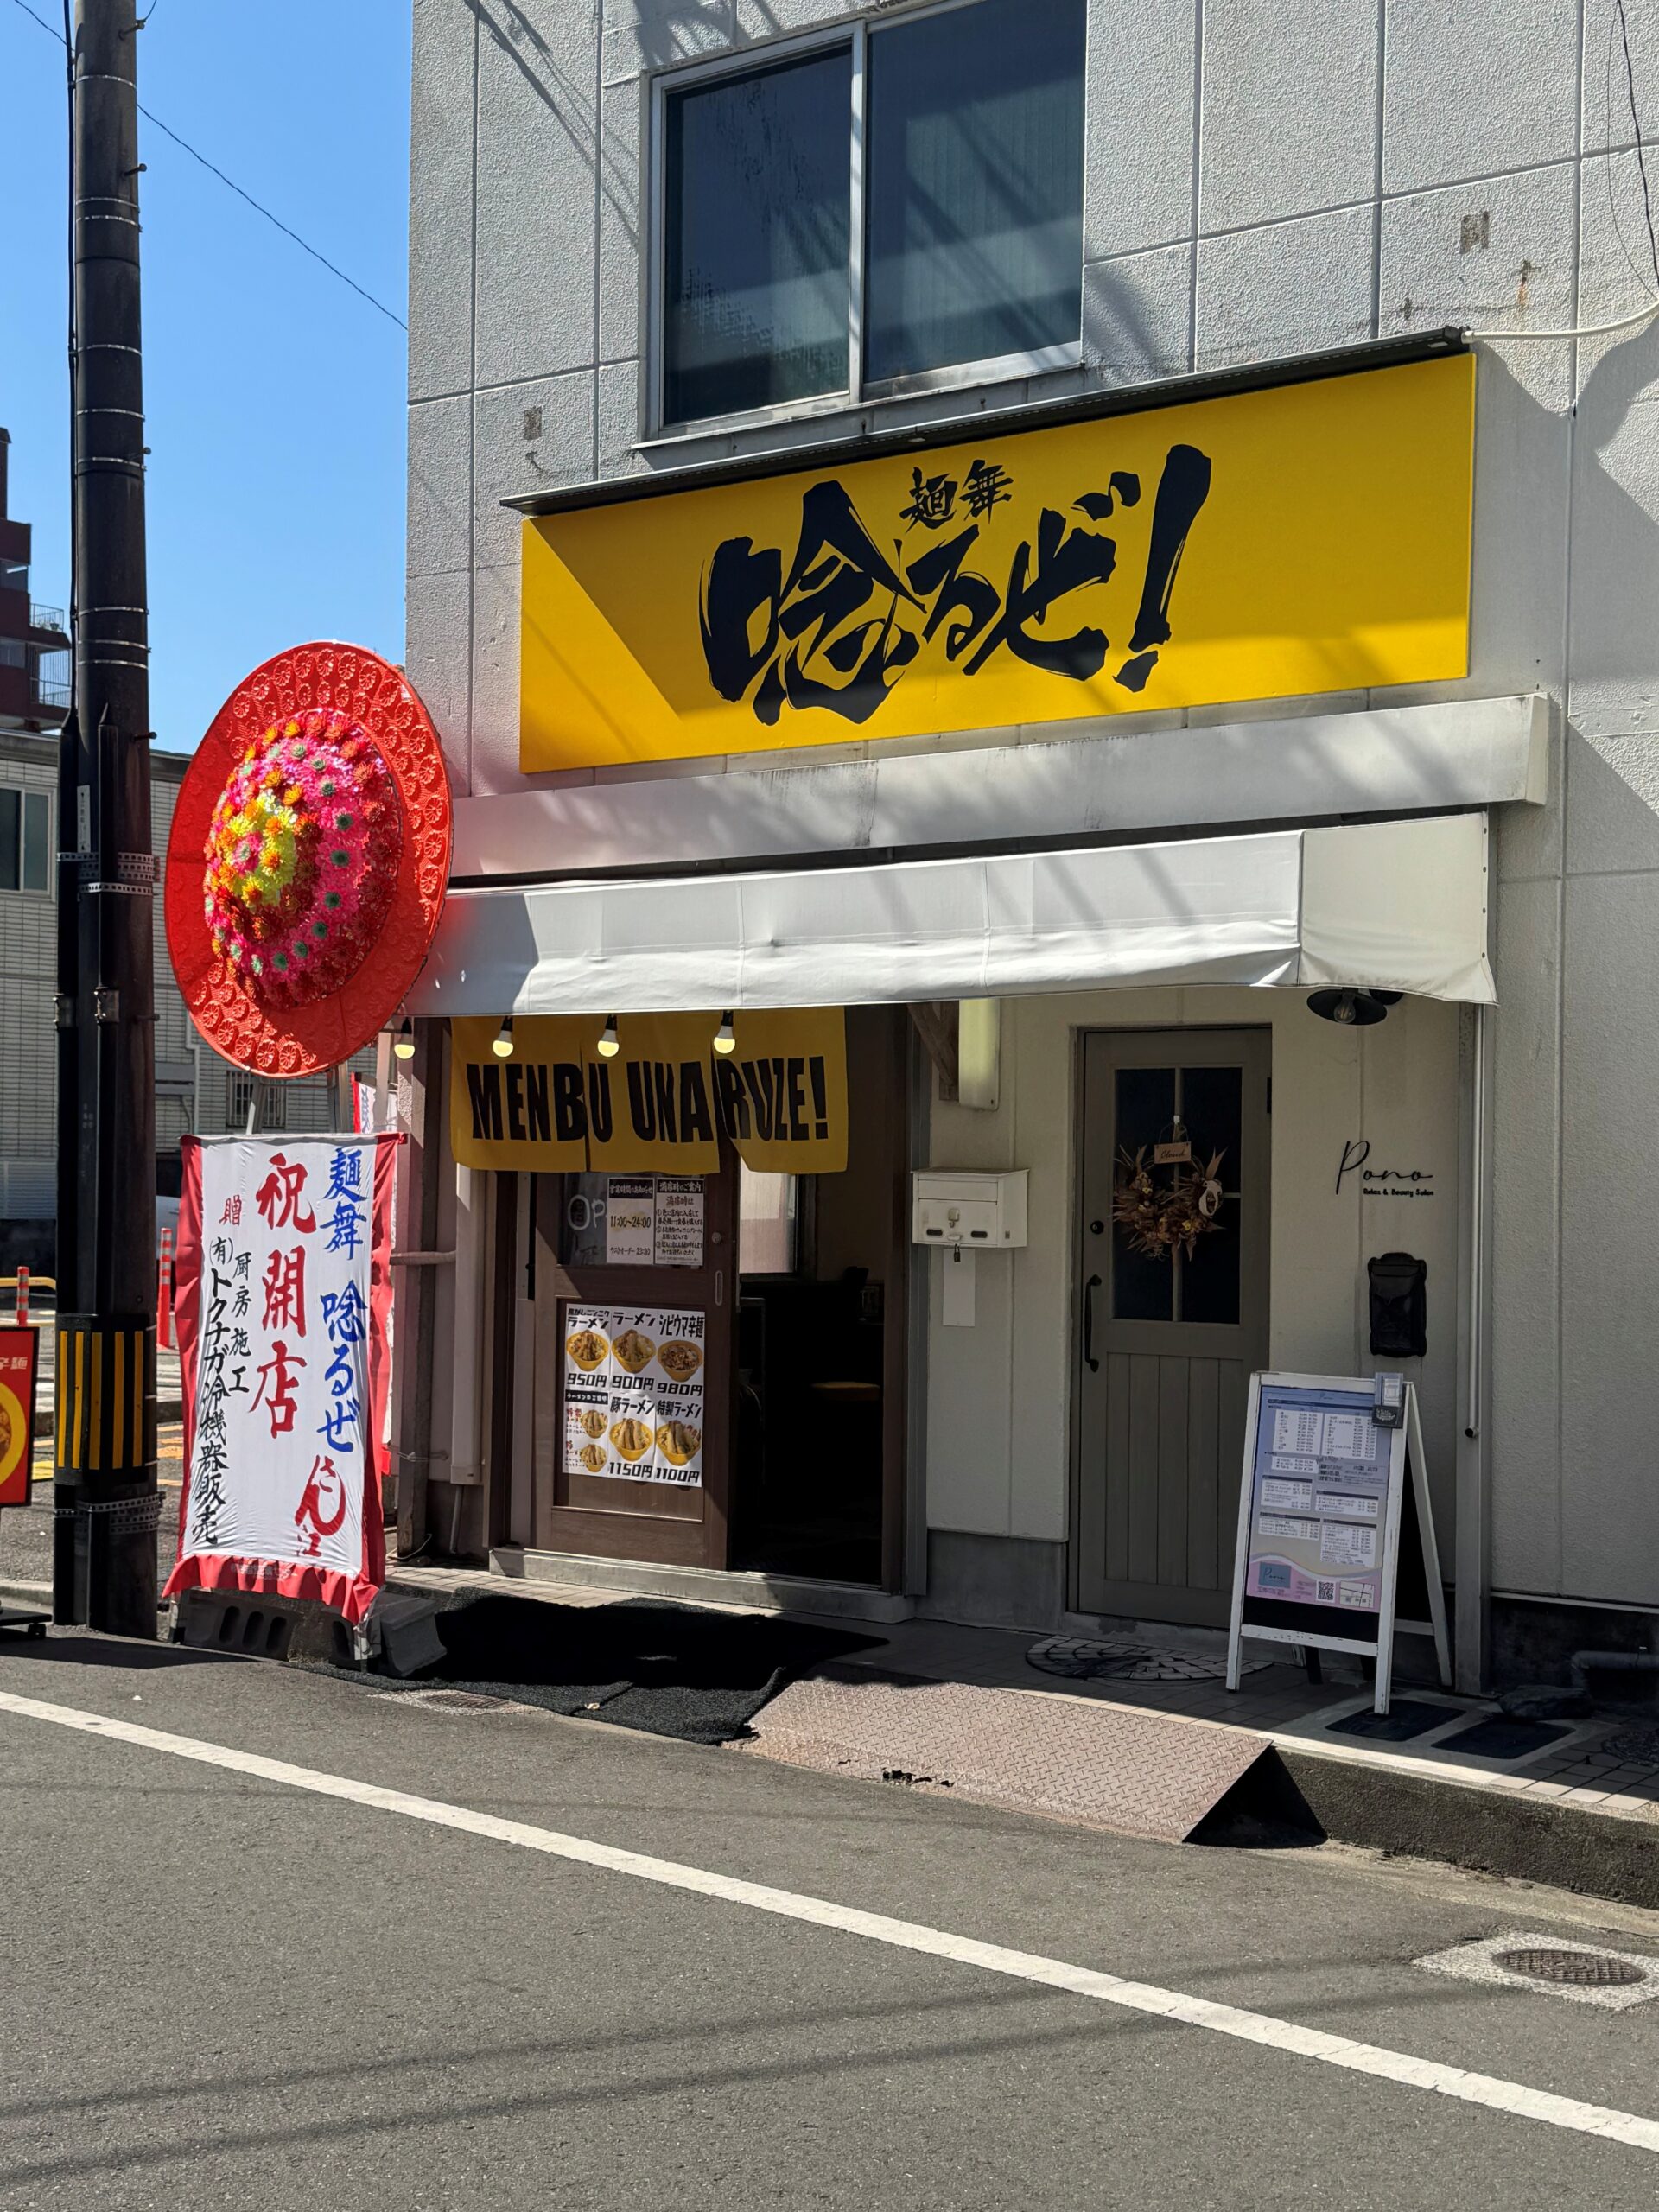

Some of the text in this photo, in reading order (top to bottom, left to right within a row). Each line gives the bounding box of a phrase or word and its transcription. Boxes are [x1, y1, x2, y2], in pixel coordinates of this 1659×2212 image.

[899, 460, 1014, 533] 麺舞
[467, 1062, 613, 1142] MENBU
[626, 1056, 829, 1143] UNARUZE!
[1336, 1141, 1433, 1195] Pono
[219, 1194, 242, 1226] 贈
[320, 1147, 369, 1261] 麺舞
[249, 1153, 318, 1439] 祝開店
[228, 1252, 252, 1393] 厨房施工
[568, 1316, 609, 1329] ラーメン
[613, 1312, 656, 1327] ラーメン
[567, 1373, 607, 1388] 950円
[612, 1376, 654, 1391] 900円
[657, 1382, 703, 1396] 980円
[610, 1396, 655, 1415] 豚ラーメン
[657, 1400, 702, 1419] 特製ラーメン
[609, 1462, 653, 1478] 1150円
[656, 1467, 700, 1483] 1100円
